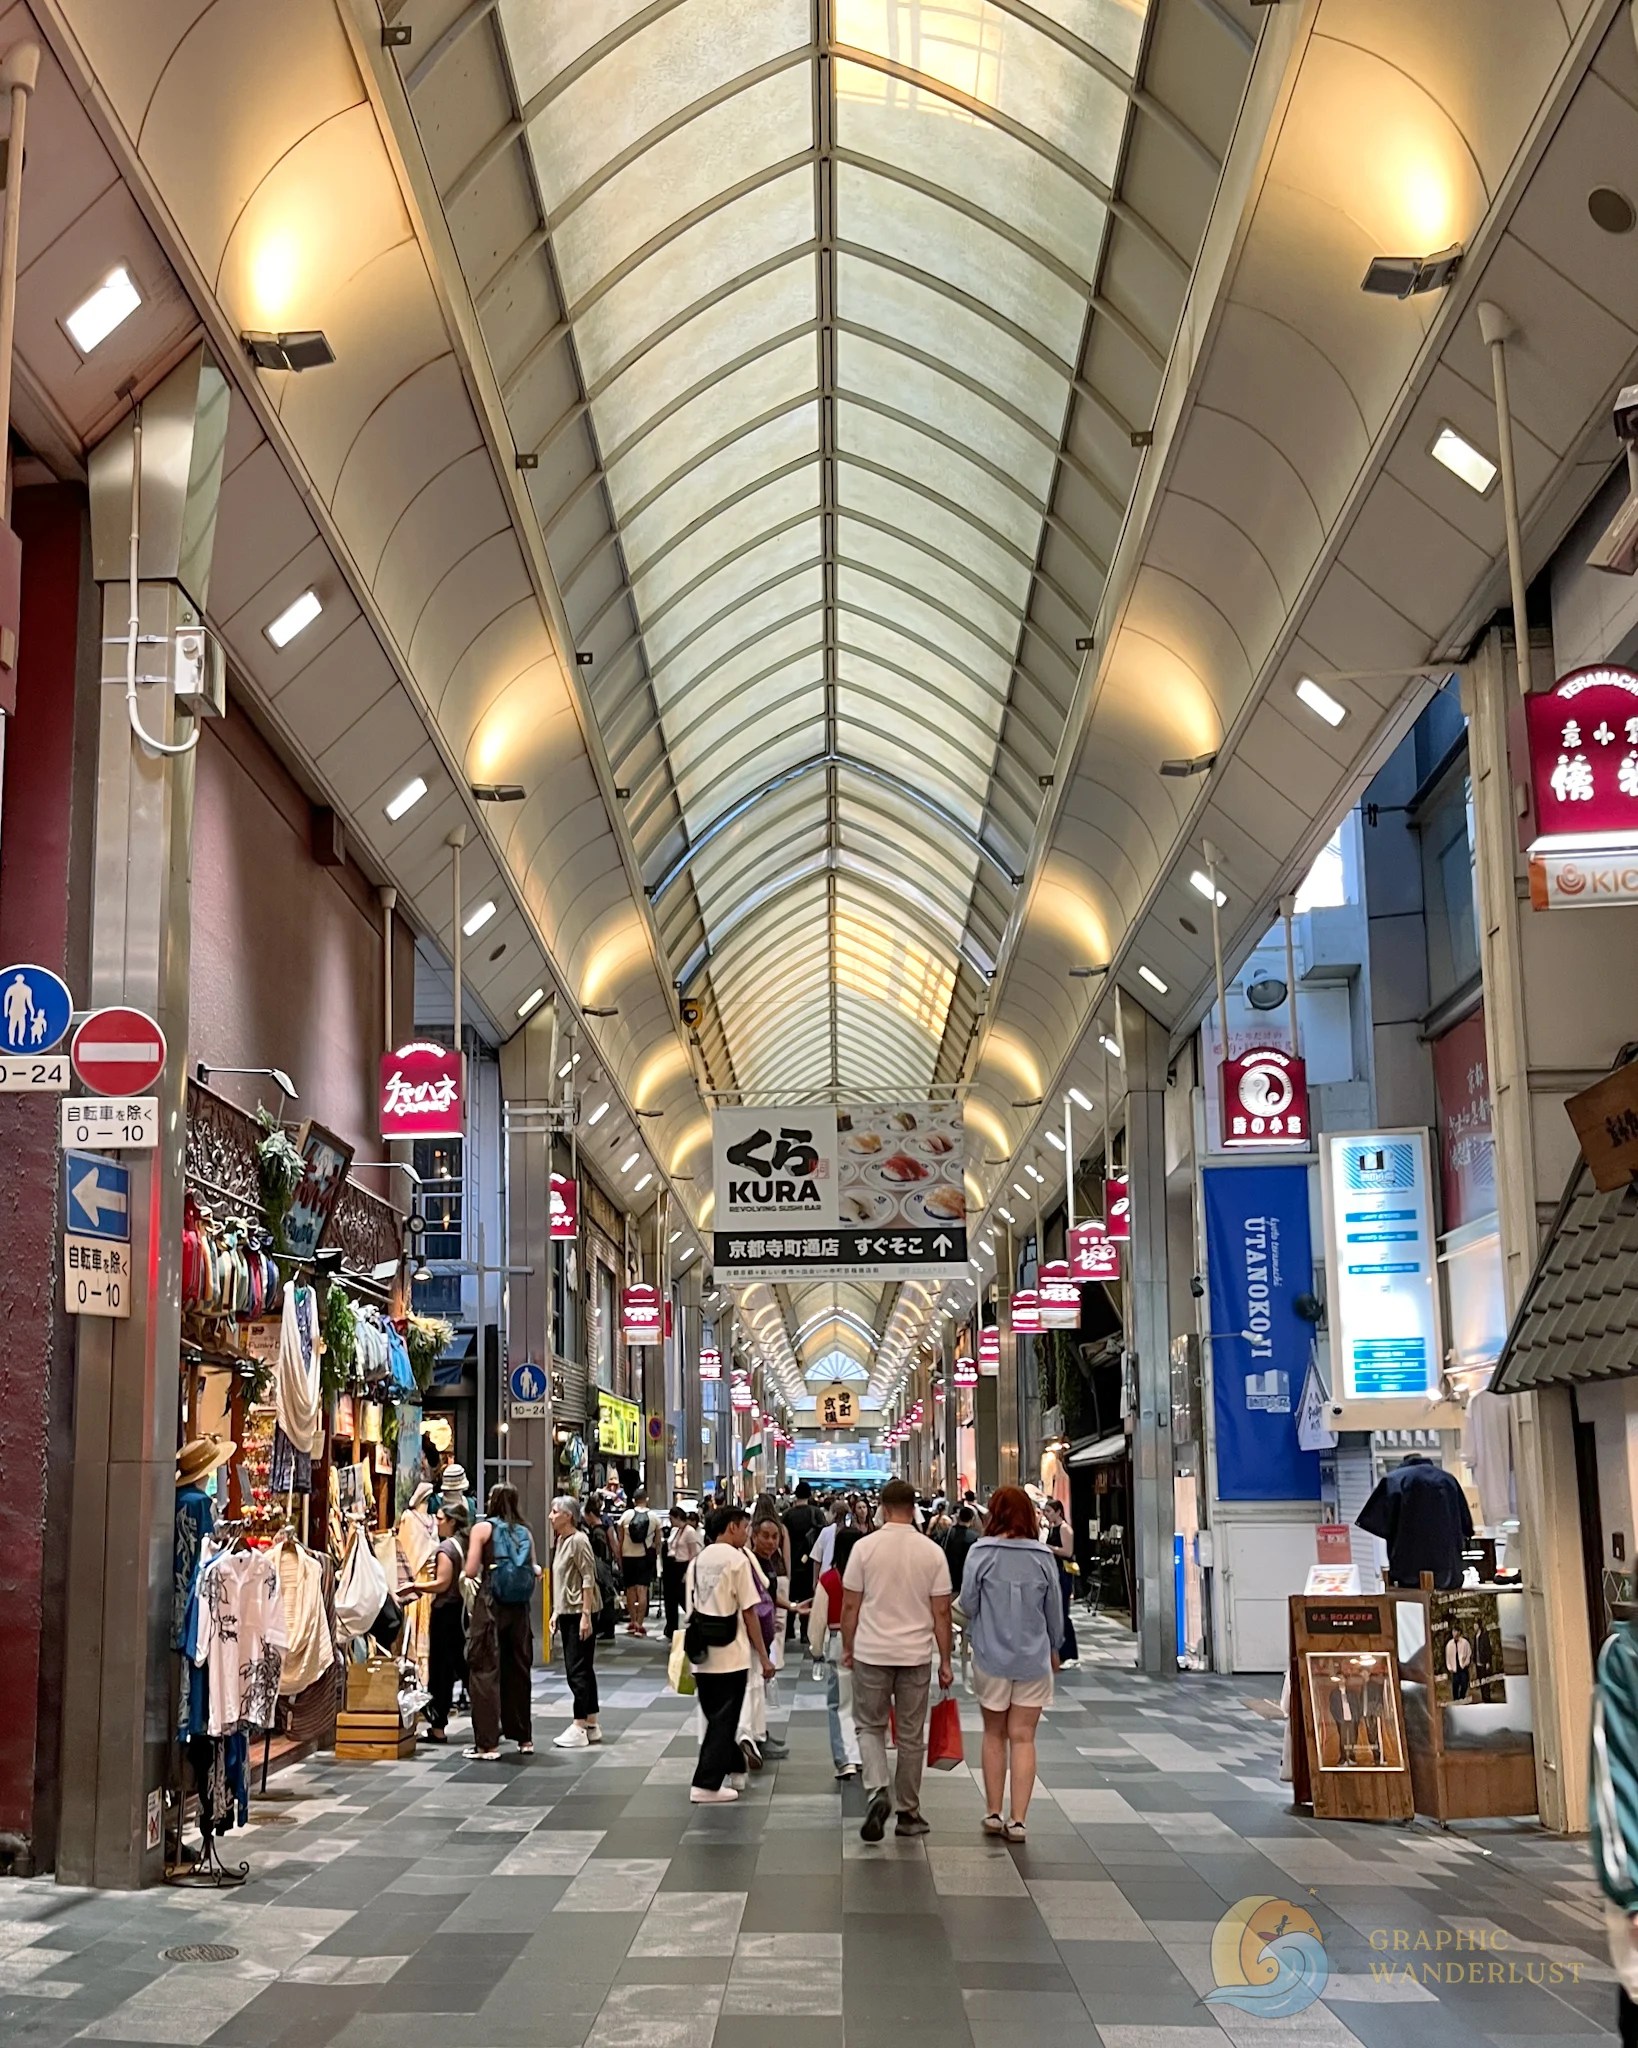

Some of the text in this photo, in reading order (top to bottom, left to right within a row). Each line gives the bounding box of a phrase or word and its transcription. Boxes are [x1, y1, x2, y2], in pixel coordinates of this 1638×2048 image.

[67, 1105, 153, 1122] 自転車を除く
[726, 1127, 819, 1178] くら
[728, 1179, 821, 1204] KURA
[729, 1205, 777, 1213] REVOLVING
[778, 1204, 803, 1212] SUSHI
[728, 1236, 924, 1260] 京都寺町通店 すぐそこ
[68, 1245, 128, 1276] 自転車を除く
[513, 1406, 545, 1415] 10-24
